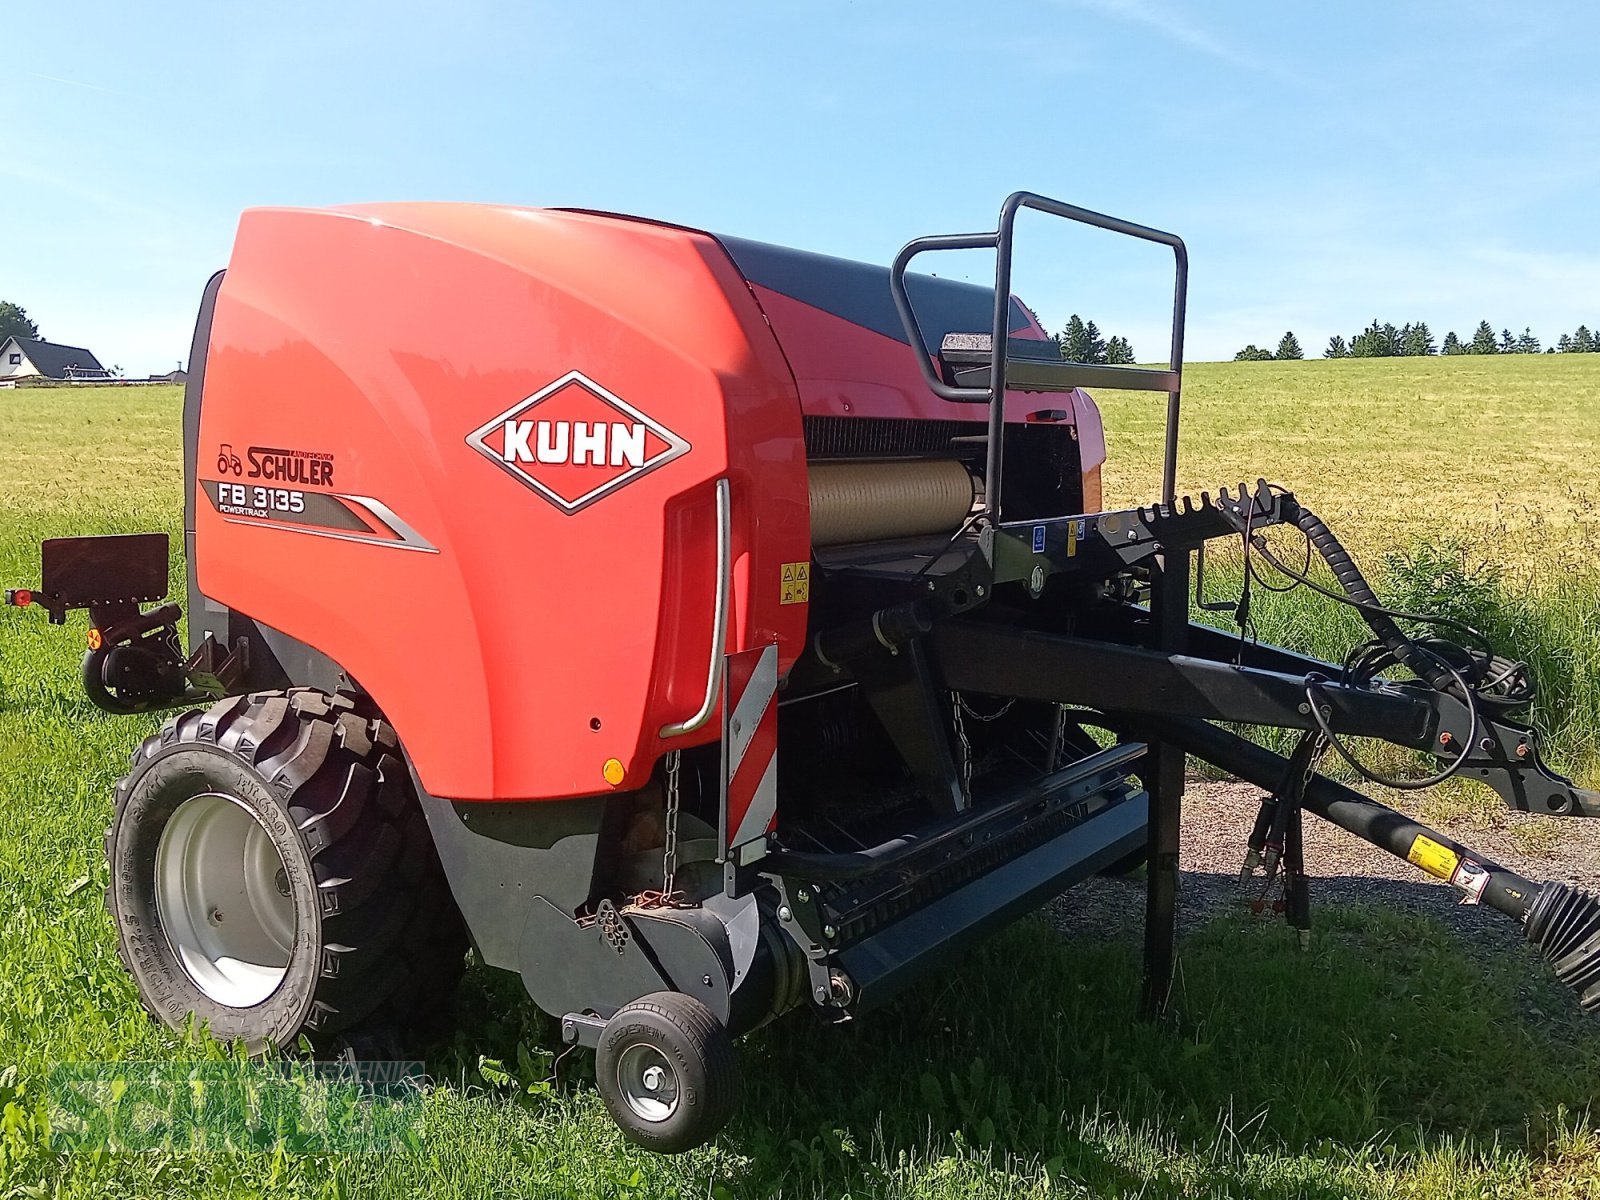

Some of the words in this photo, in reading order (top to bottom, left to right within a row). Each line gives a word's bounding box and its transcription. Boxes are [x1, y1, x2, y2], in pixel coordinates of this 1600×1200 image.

[503, 420, 647, 468] KUHN
[247, 446, 334, 487] SCHULER
[218, 482, 246, 506] FB
[253, 487, 305, 513] 3135
[219, 504, 269, 518] POWERTRACK
